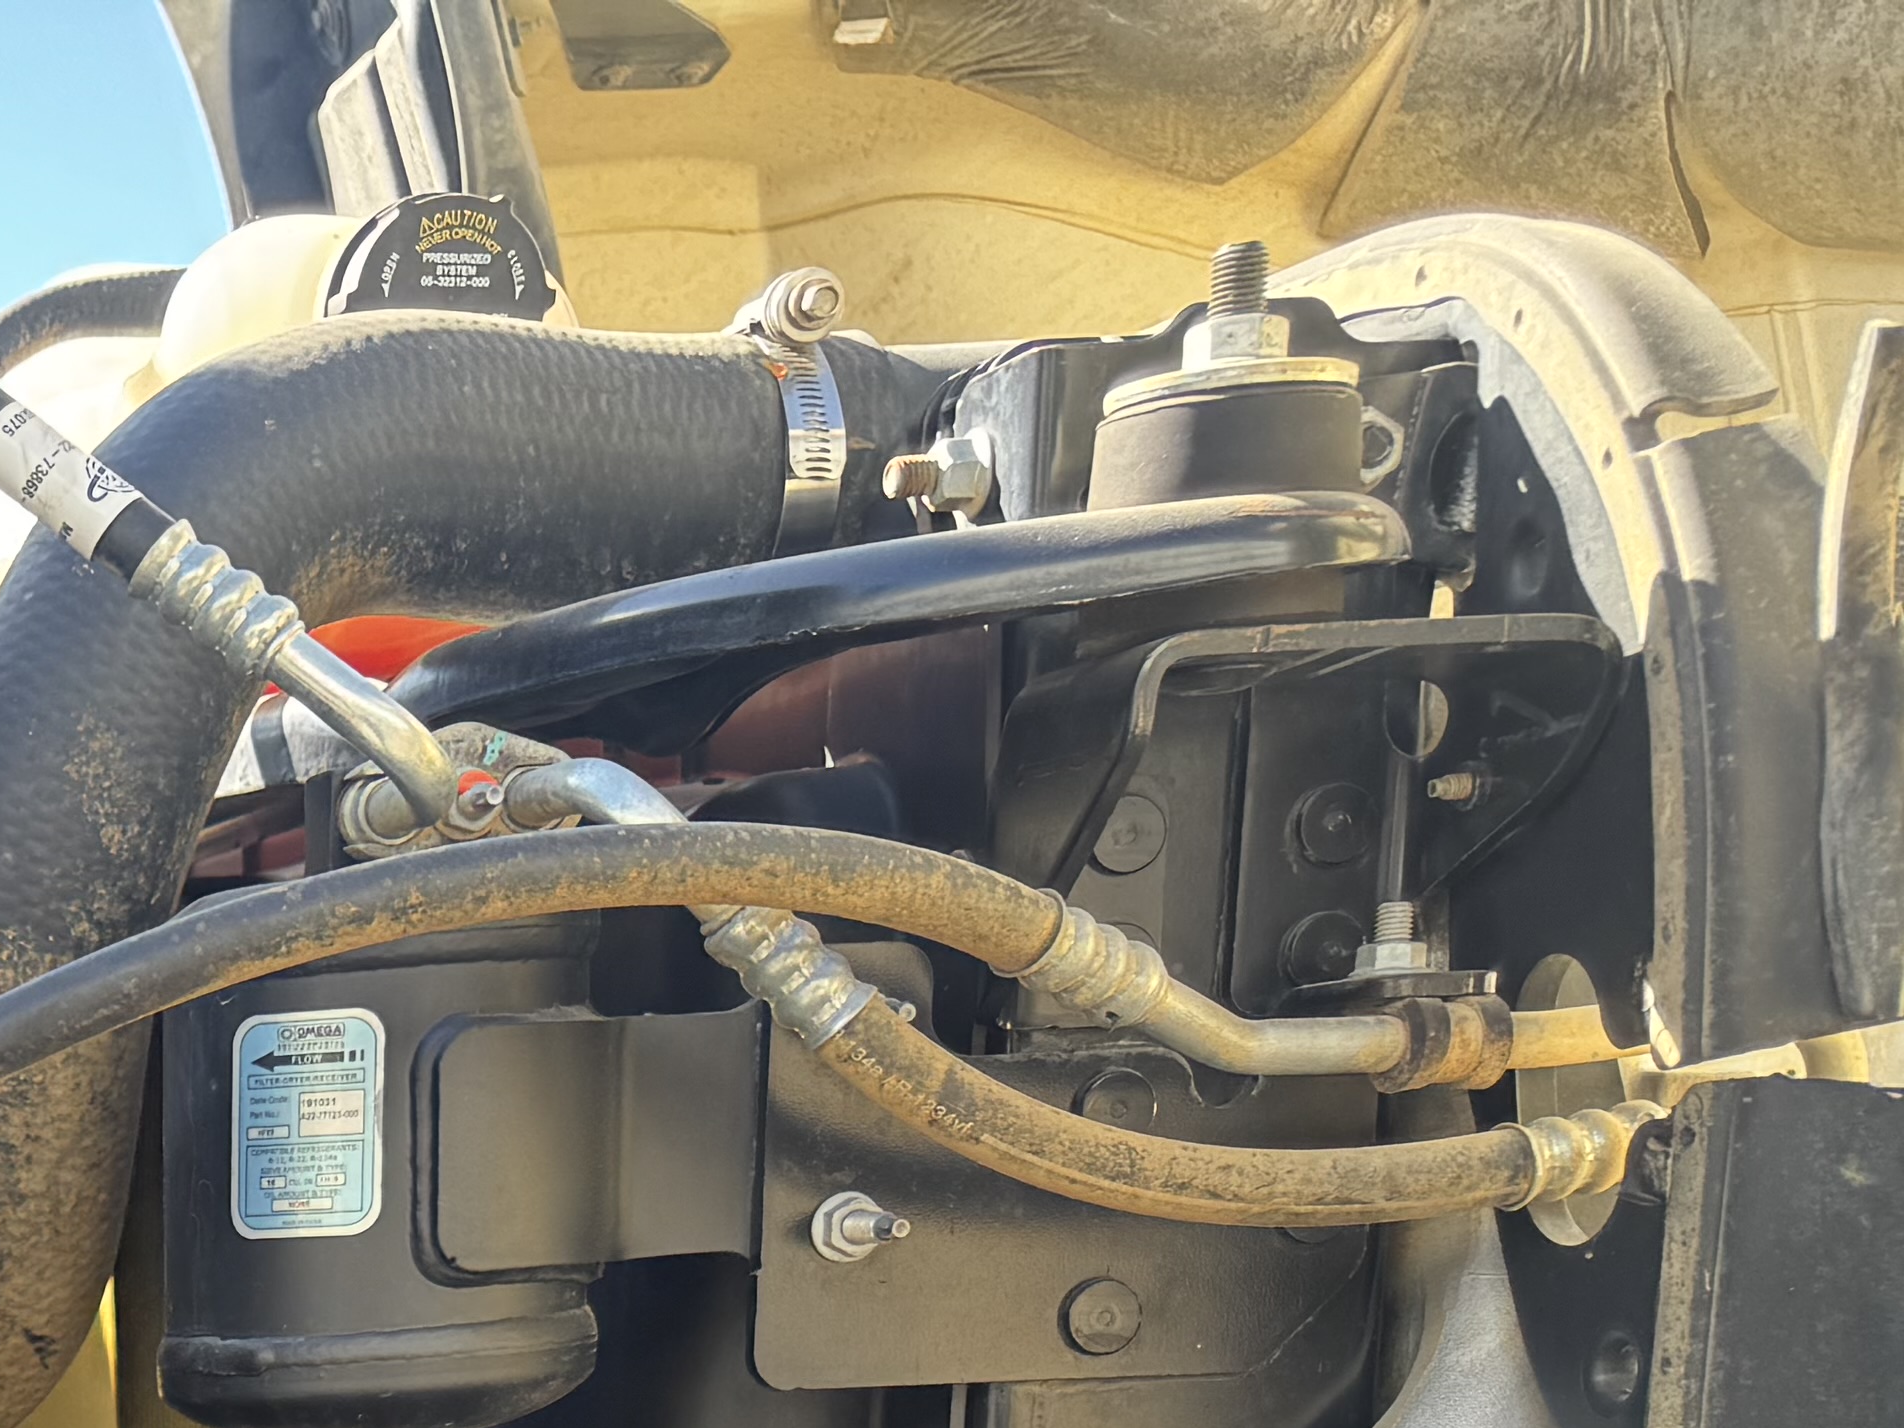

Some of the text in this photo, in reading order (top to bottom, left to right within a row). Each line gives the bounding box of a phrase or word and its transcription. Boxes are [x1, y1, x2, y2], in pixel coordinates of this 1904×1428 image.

[433, 209, 498, 235] CAUTION
[415, 228, 503, 256] NEVER OPEN HOT
[422, 252, 492, 265] PRESSURIZED
[436, 265, 477, 276] SYSTEM
[291, 1054, 323, 1065] FLOW
